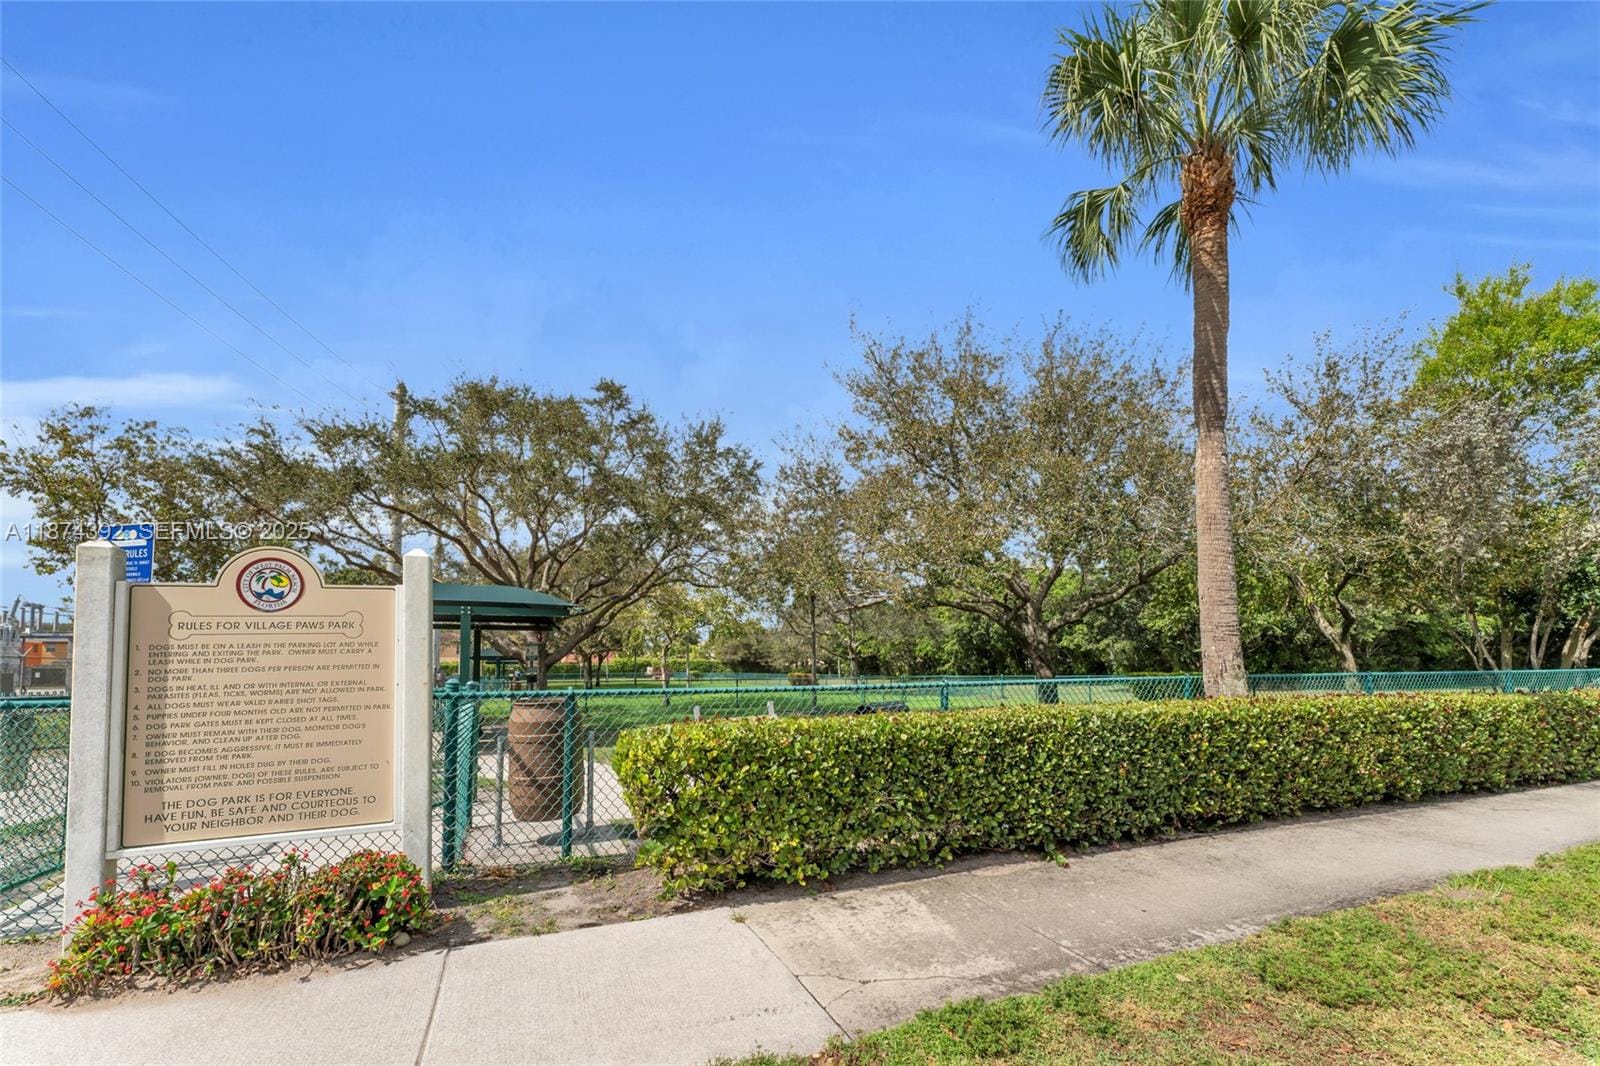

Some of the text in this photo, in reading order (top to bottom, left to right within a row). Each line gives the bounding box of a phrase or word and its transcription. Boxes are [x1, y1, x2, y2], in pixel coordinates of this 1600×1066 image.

[254, 600, 288, 609] FLORIDA
[177, 621, 355, 630] RULES FOR VILLAGE PAWS PARK
[316, 739, 363, 747] IMMEDIATELY
[145, 777, 192, 786] VIOLATORS
[161, 787, 356, 810] THE DOG PARK IS FOR EVERYONE.
[144, 796, 376, 823] HAVE BE SAFE AND COURTEOUS TO
[164, 808, 360, 832] YOUR NEIGHBOR AND THEIR DOG.
